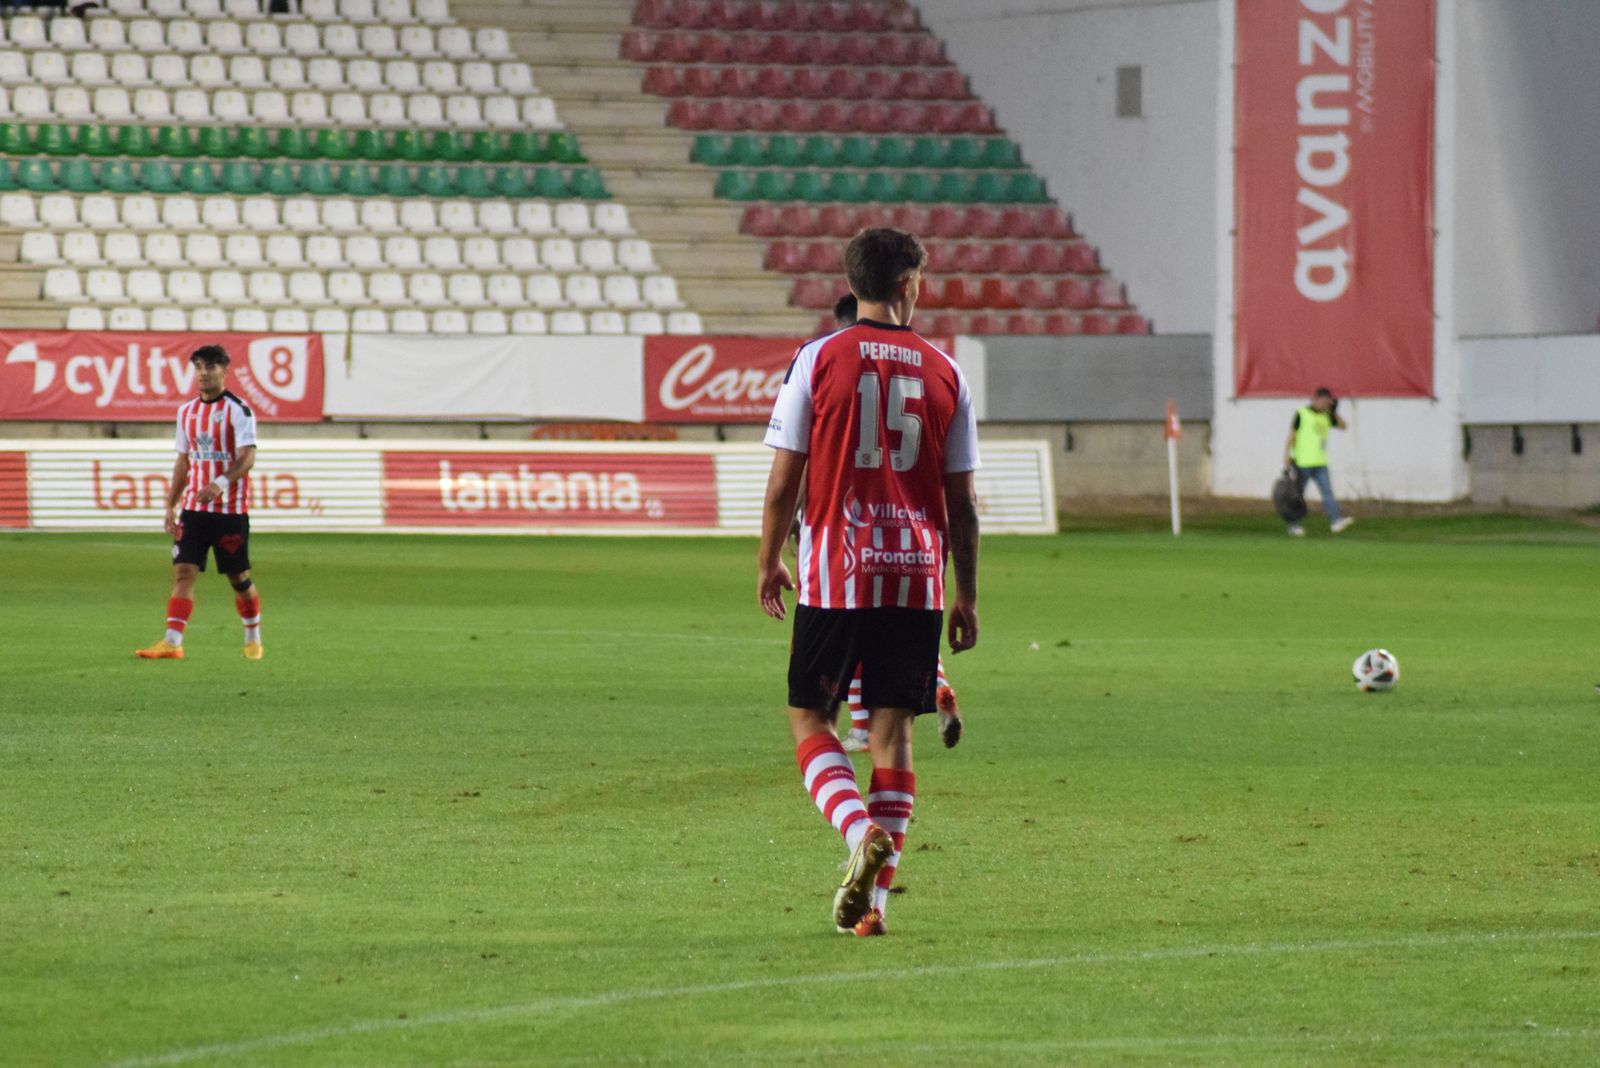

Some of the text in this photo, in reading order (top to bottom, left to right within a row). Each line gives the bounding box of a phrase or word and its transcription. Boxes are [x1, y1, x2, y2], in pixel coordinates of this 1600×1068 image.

[1294, 0, 1351, 301] avanz
[270, 347, 293, 387] 8
[859, 342, 922, 366] PEREIRO
[855, 372, 924, 472] 15
[439, 460, 640, 511] lantania
[860, 547, 936, 565] Pronatal
[861, 564, 899, 574] Medical
